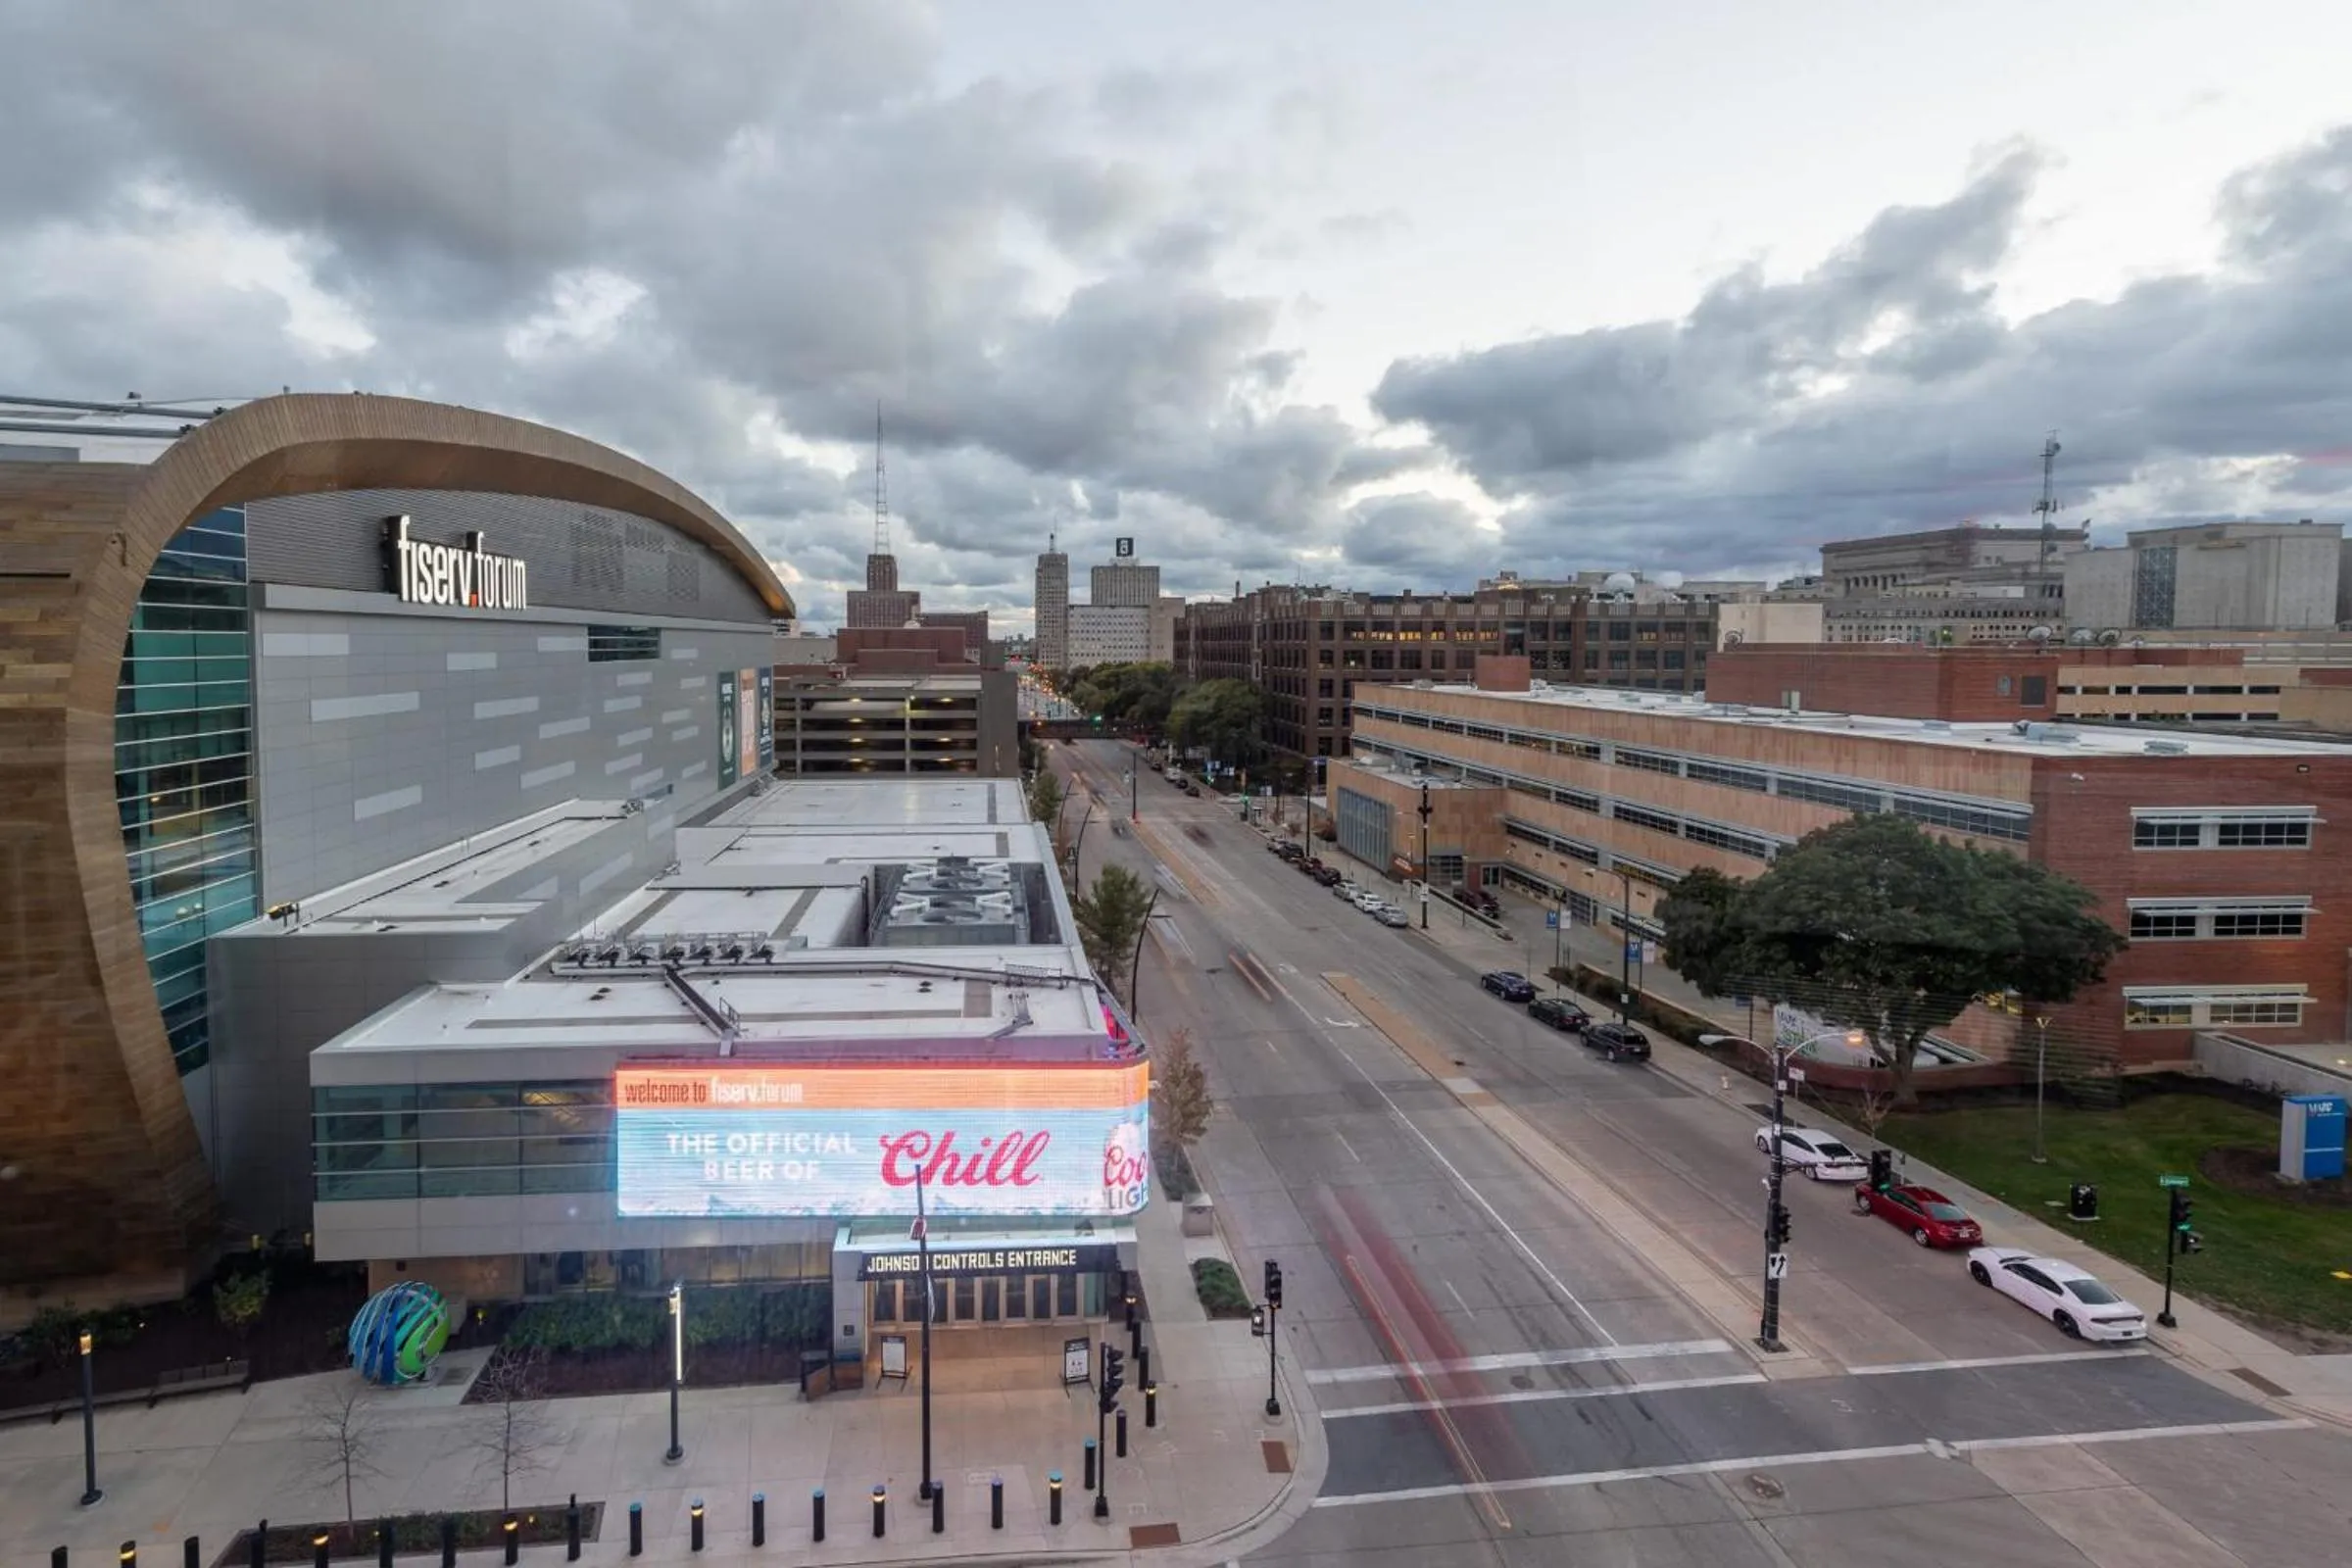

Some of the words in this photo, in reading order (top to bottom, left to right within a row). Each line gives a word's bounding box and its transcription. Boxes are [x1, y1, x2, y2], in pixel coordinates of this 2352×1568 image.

[625, 1078, 689, 1103] welcome
[693, 1081, 707, 1102] to
[667, 1133, 718, 1153] THE
[726, 1132, 858, 1153] OFFICIAL
[704, 1159, 775, 1180] BEER
[783, 1159, 820, 1180] OF
[879, 1130, 1051, 1186] Chill
[867, 1254, 929, 1272] JOHNSO
[933, 1251, 1004, 1269] CONTROLS
[1008, 1249, 1077, 1266] ENTRANCE
